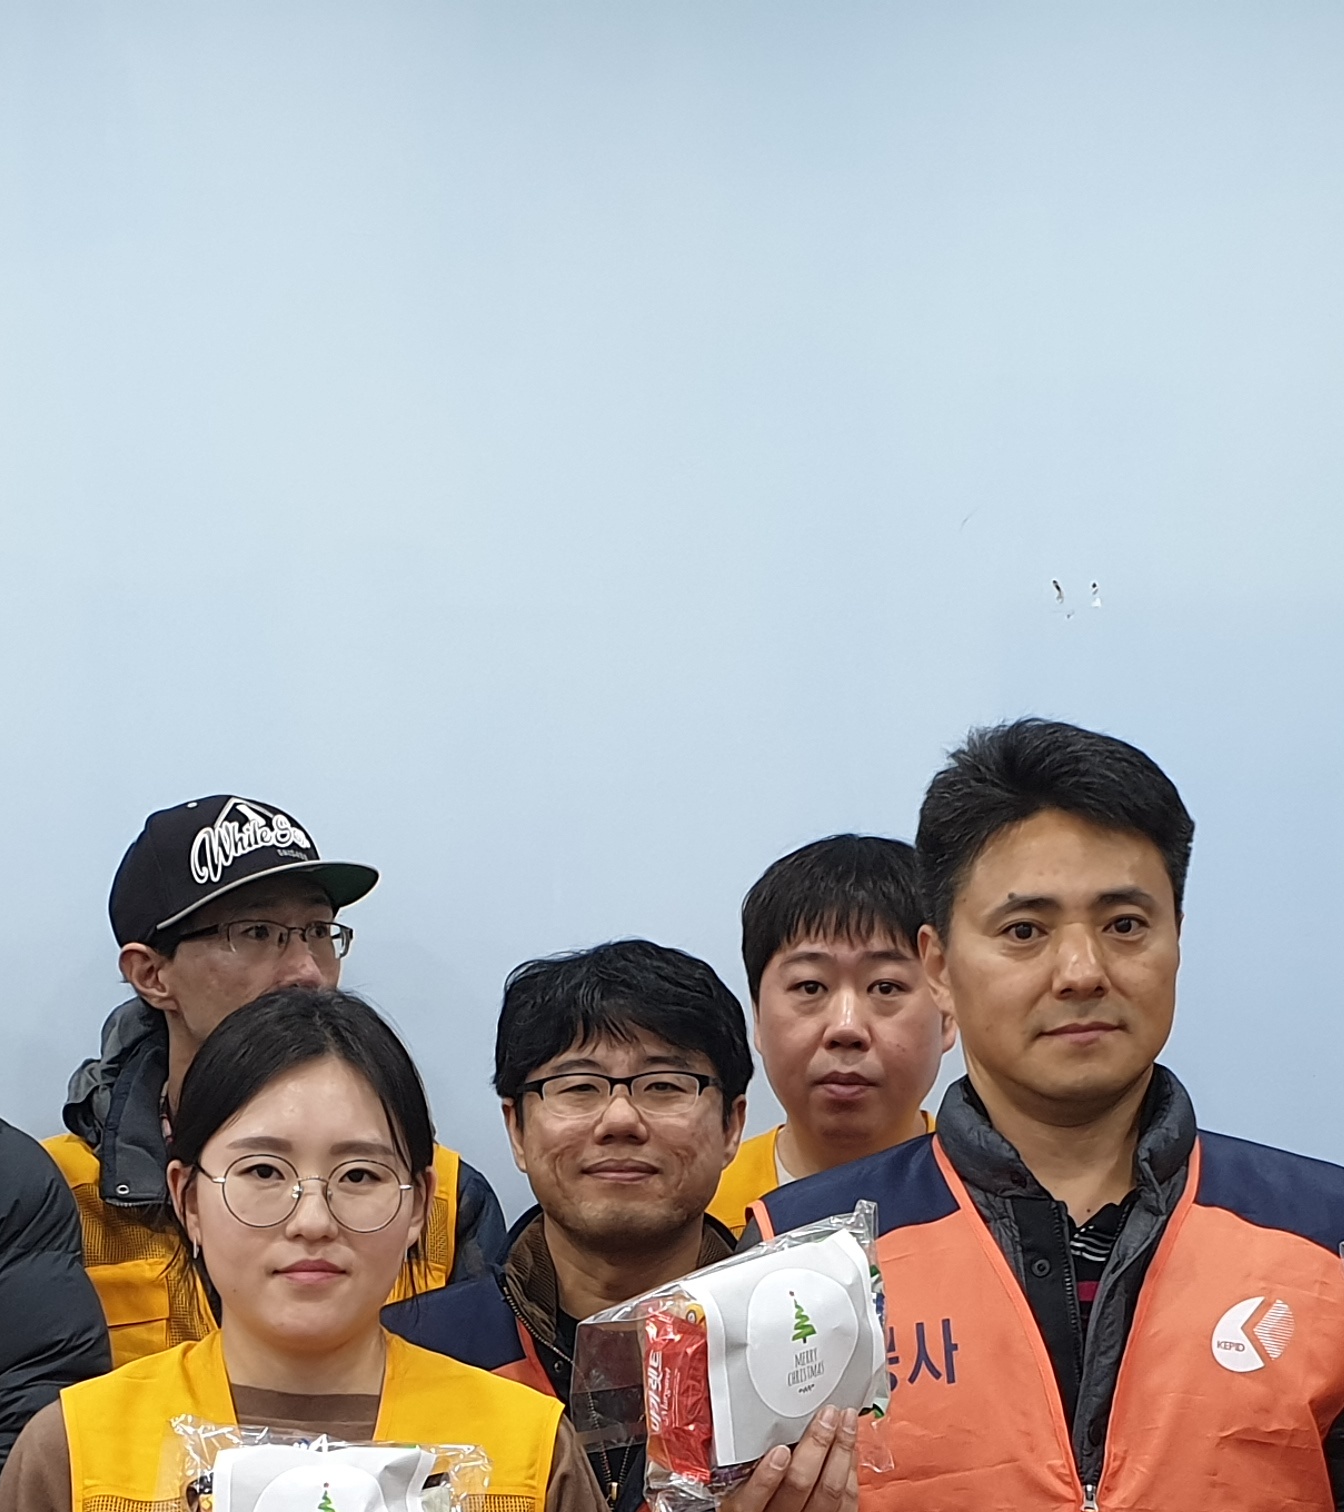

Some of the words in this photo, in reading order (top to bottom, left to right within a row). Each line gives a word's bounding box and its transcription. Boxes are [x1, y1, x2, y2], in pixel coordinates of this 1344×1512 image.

[1217, 1340, 1246, 1353] KEPID
[794, 1348, 818, 1368] MERRY
[786, 1363, 826, 1387] CHRISTMAS
